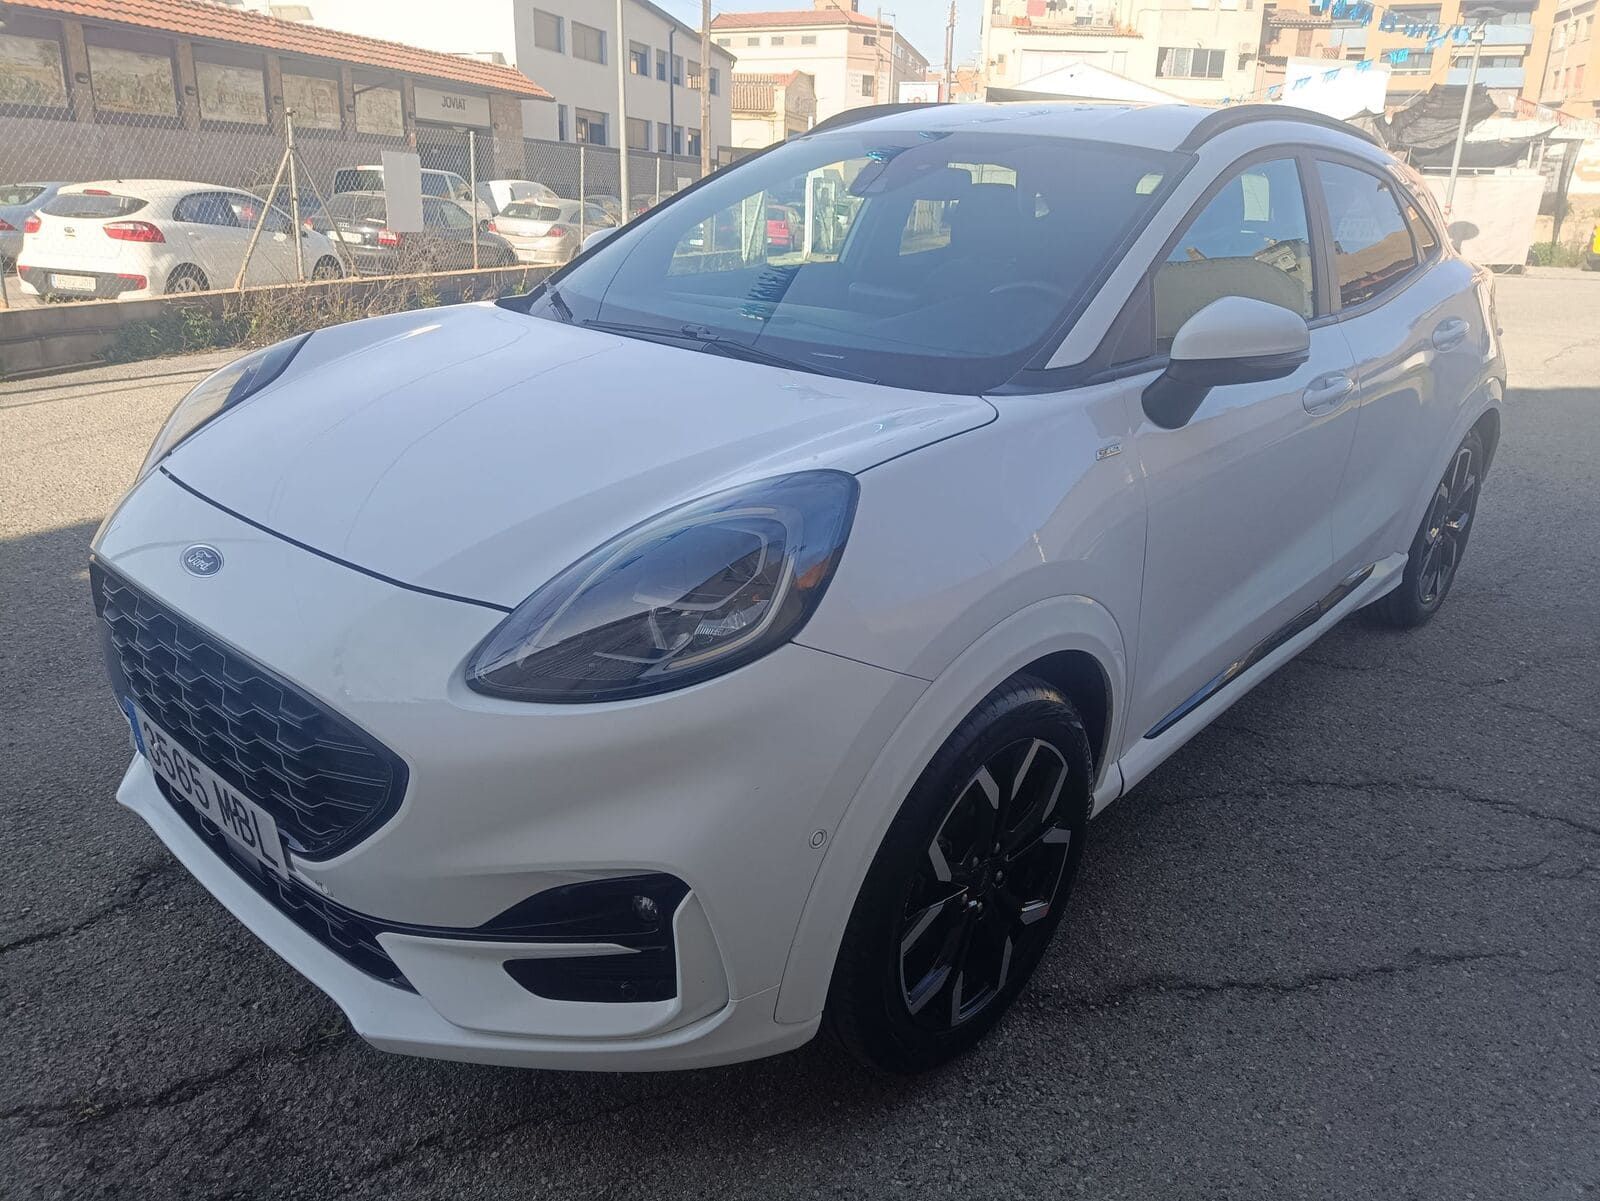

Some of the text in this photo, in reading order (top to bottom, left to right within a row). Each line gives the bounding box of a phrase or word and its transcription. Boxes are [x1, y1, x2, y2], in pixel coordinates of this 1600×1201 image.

[441, 95, 466, 111] JOVIAT
[143, 721, 279, 868] 3565 MBL
